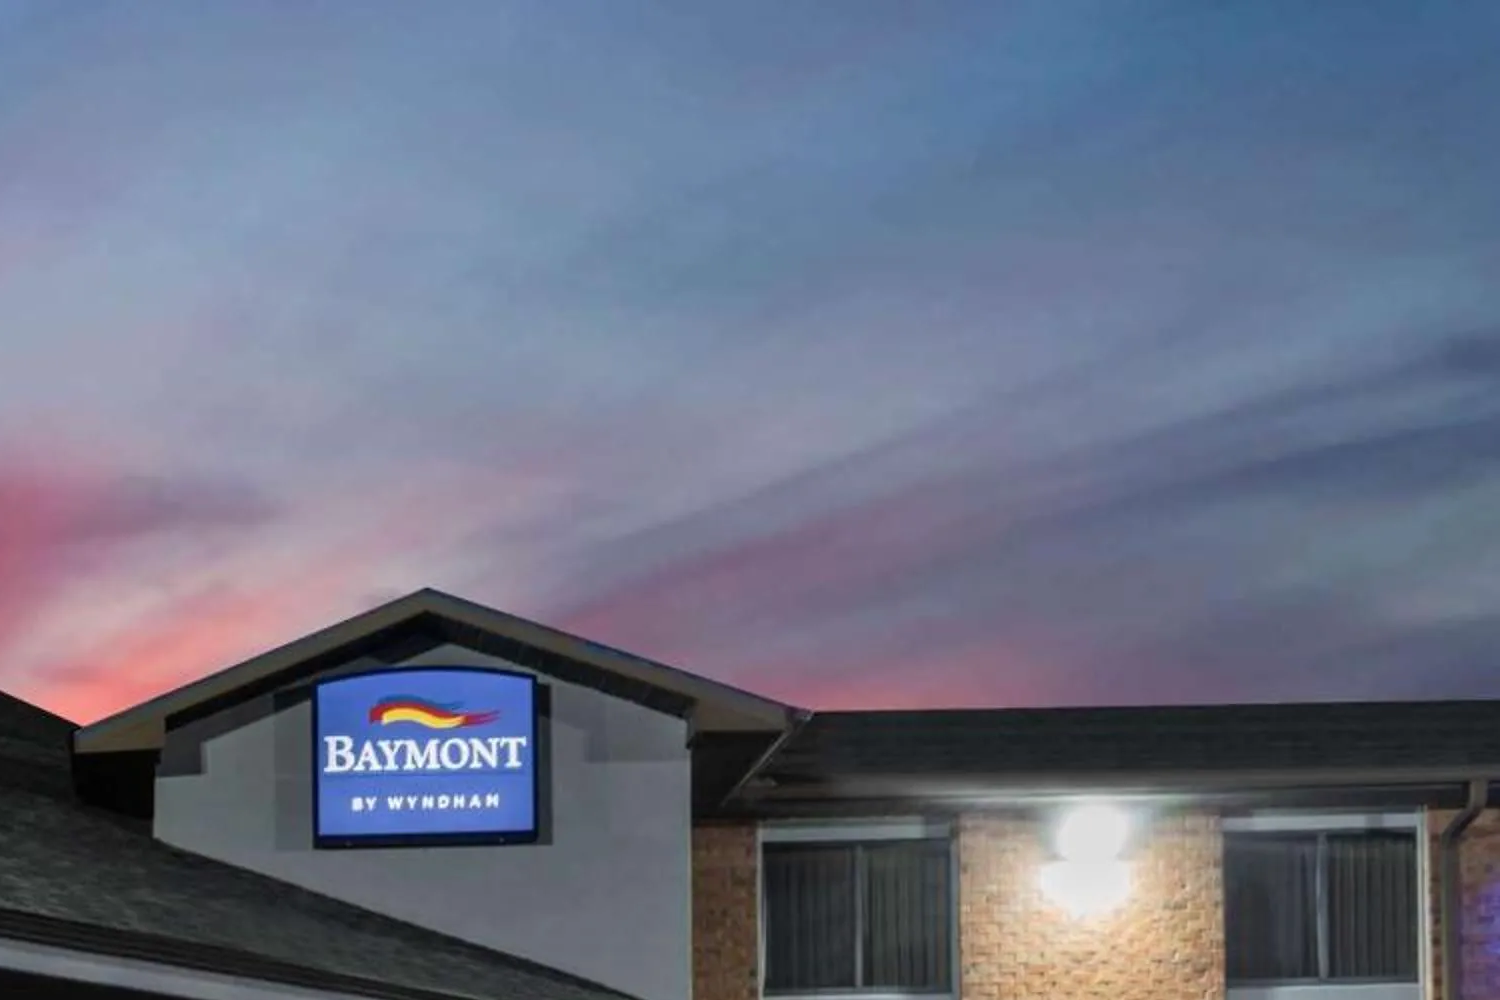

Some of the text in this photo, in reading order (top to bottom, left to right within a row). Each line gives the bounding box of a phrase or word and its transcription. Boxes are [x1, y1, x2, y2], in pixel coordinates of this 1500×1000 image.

[323, 735, 527, 773] BAYMONT
[351, 792, 500, 812] BY WYNDHAM
